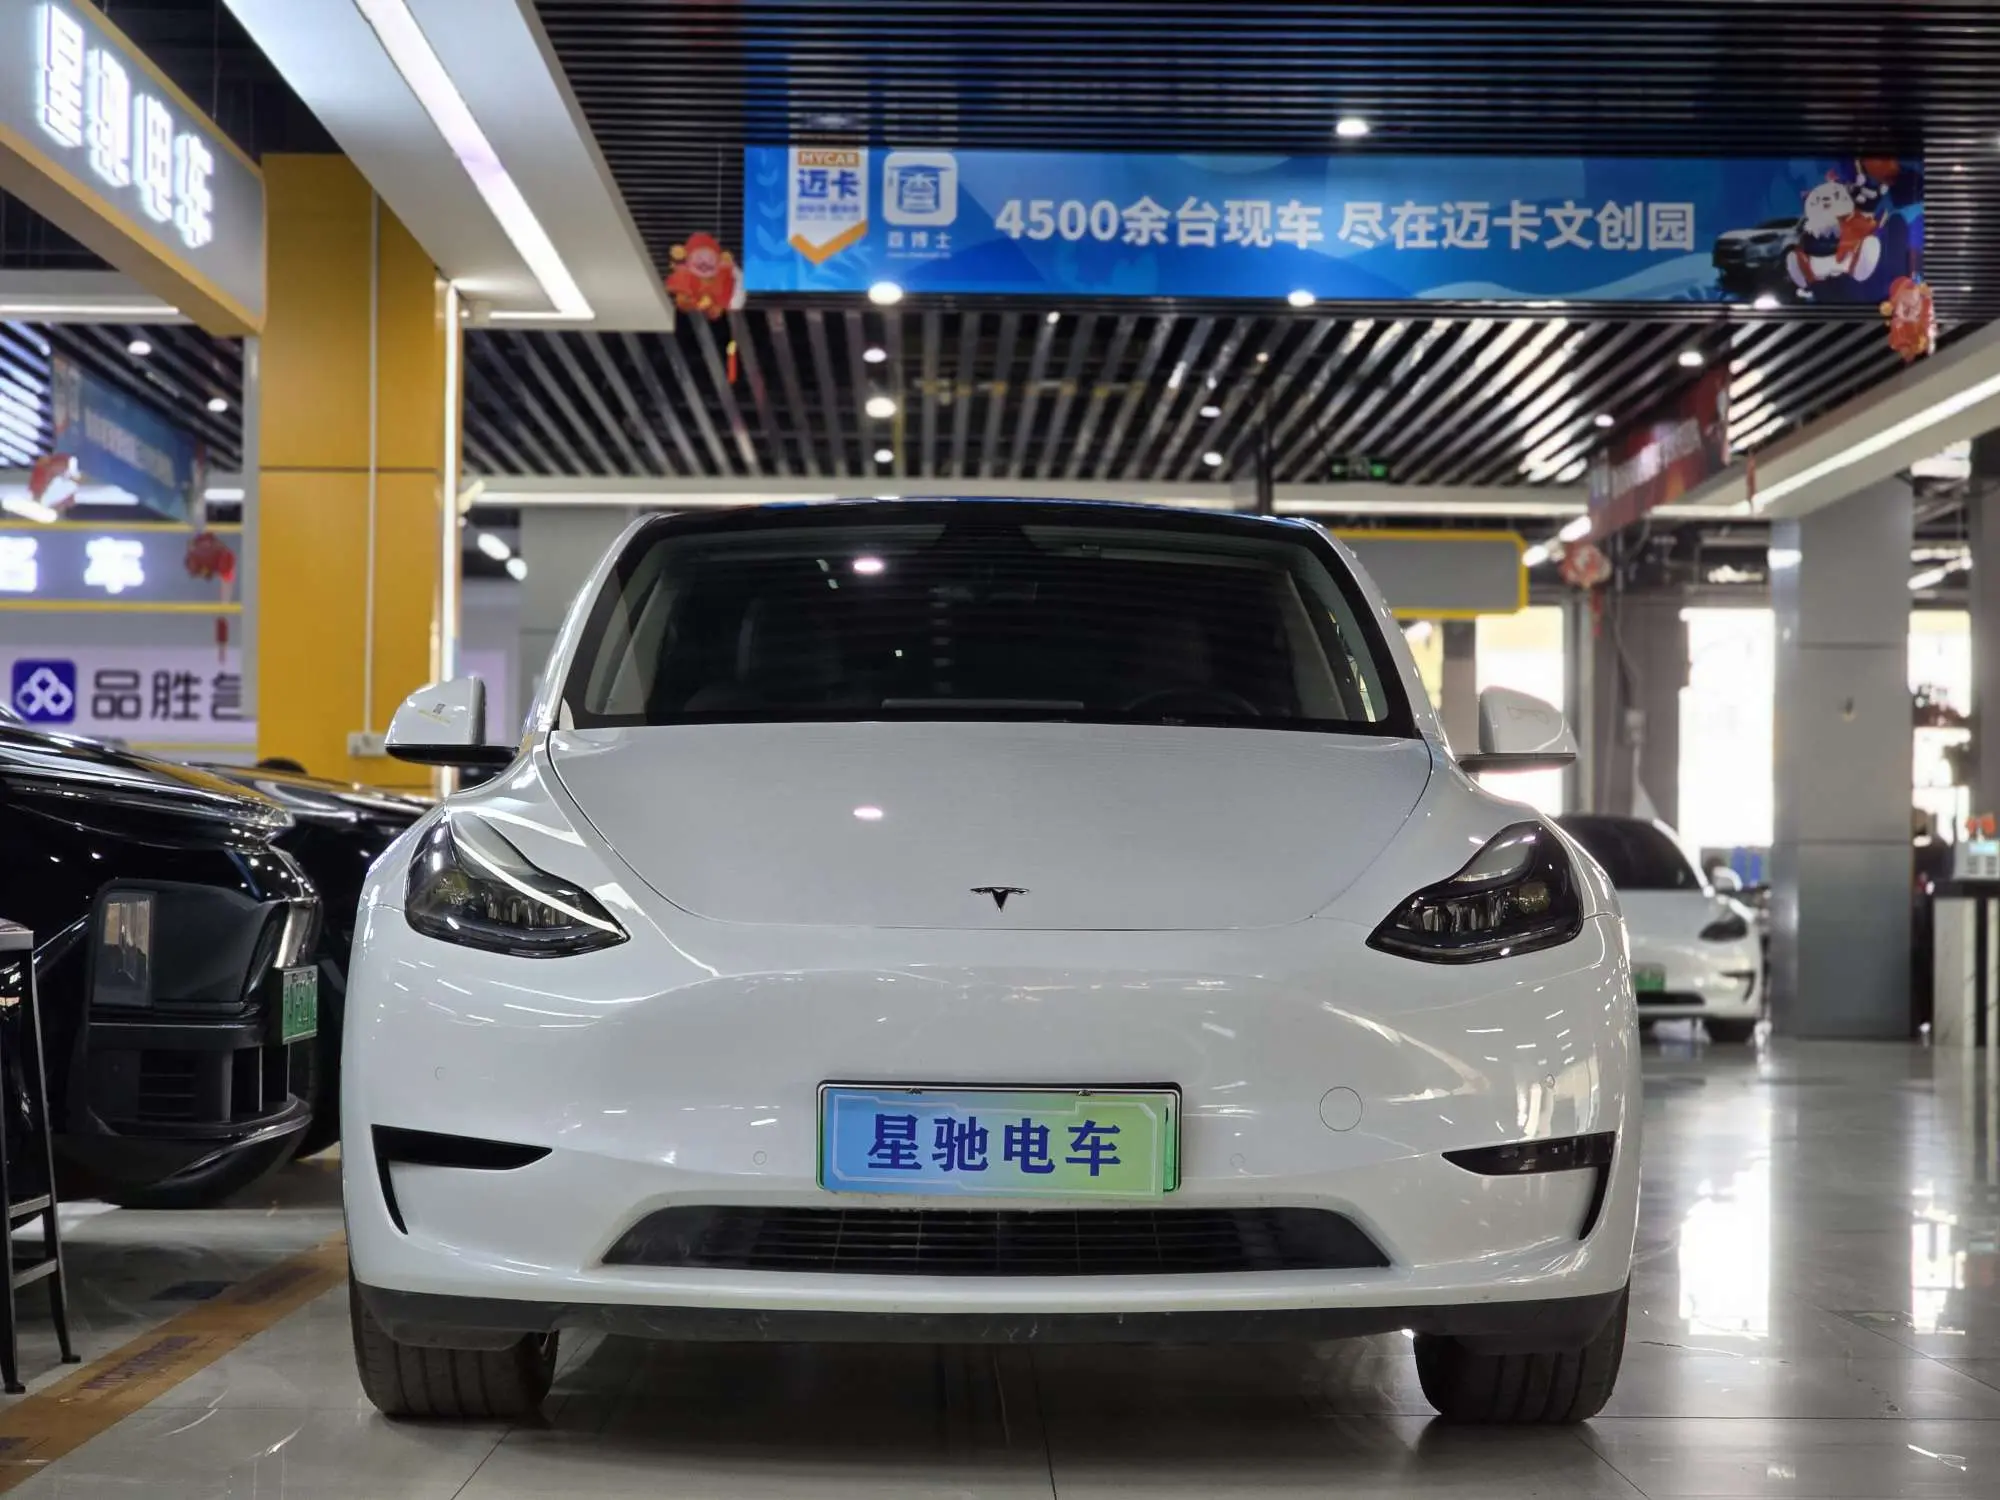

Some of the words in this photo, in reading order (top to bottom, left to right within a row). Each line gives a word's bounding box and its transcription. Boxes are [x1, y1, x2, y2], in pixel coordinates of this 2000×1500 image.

[797, 169, 860, 198] 迈卡
[995, 196, 1324, 249] 4500余台现车
[1337, 199, 1695, 251] 尽在迈卡文创园
[868, 1114, 1121, 1176] 星驰电车
